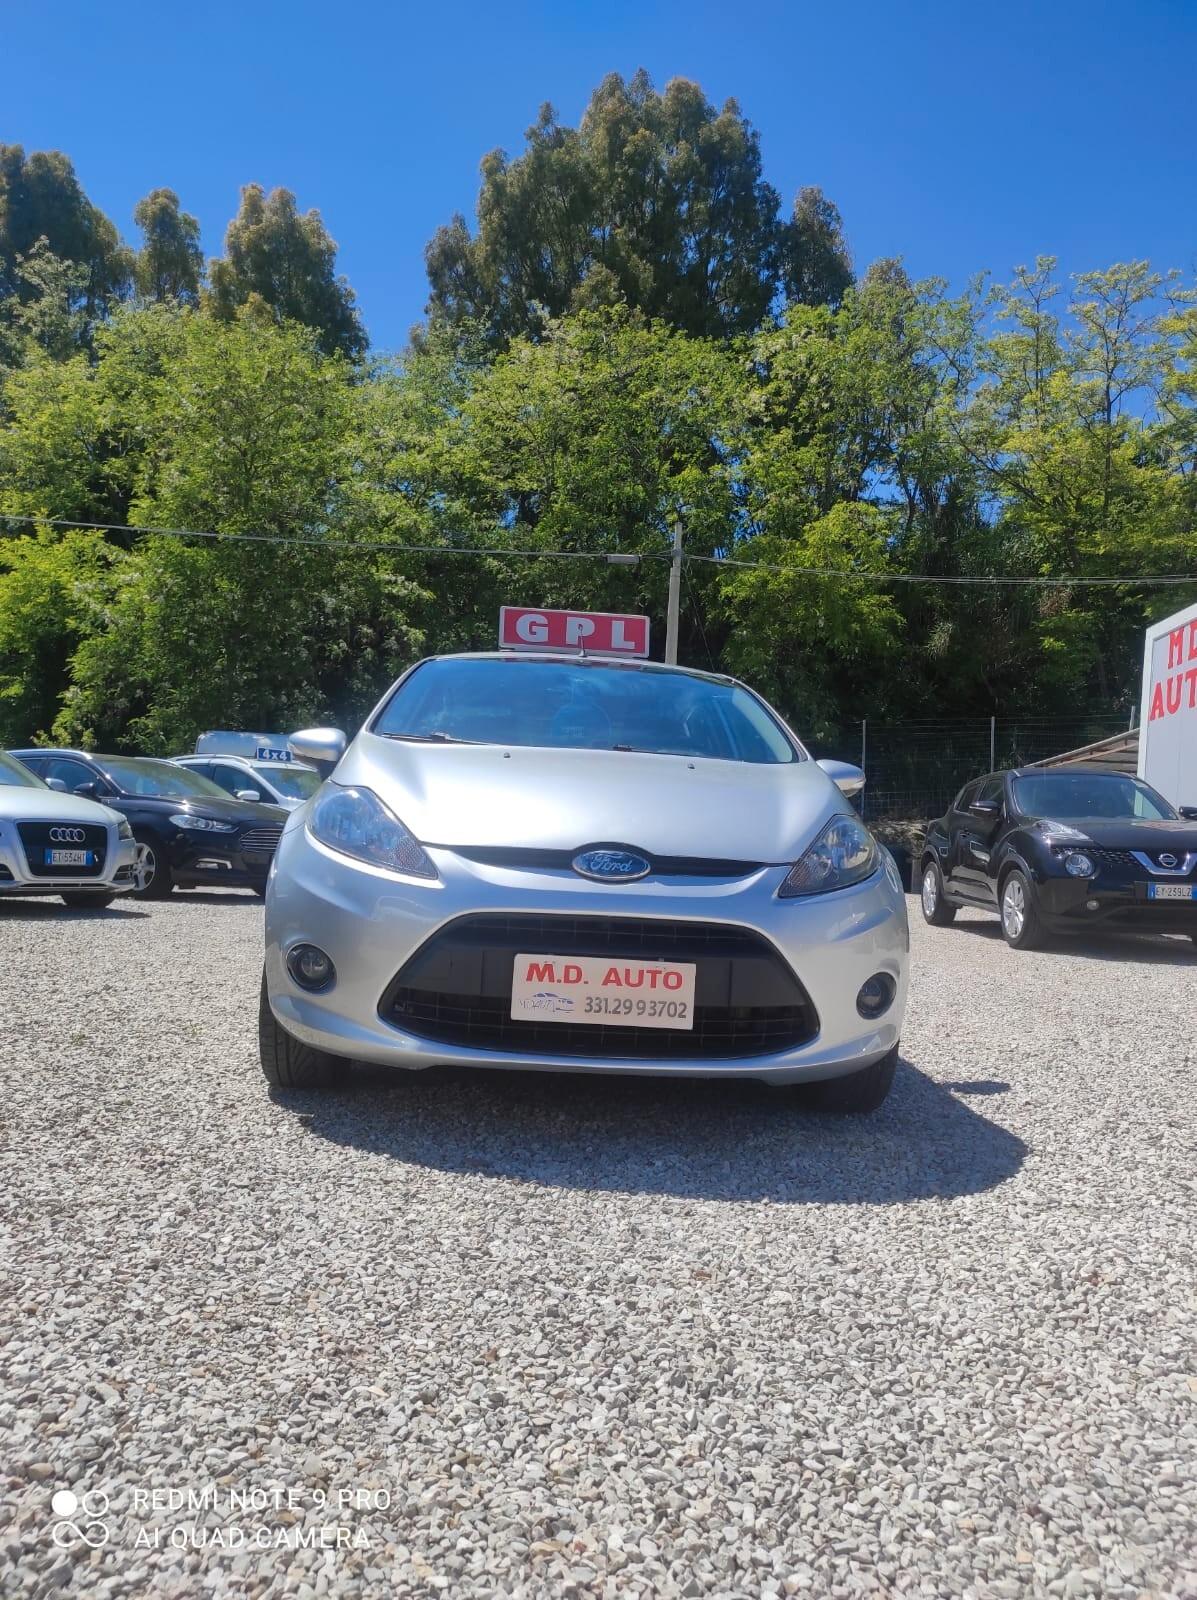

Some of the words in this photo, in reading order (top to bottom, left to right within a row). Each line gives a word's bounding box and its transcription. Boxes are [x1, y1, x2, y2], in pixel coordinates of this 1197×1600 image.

[263, 749, 287, 761] 4x4
[590, 853, 633, 872] Ford
[526, 963, 589, 985] M.D.
[601, 967, 683, 990] AUTO
